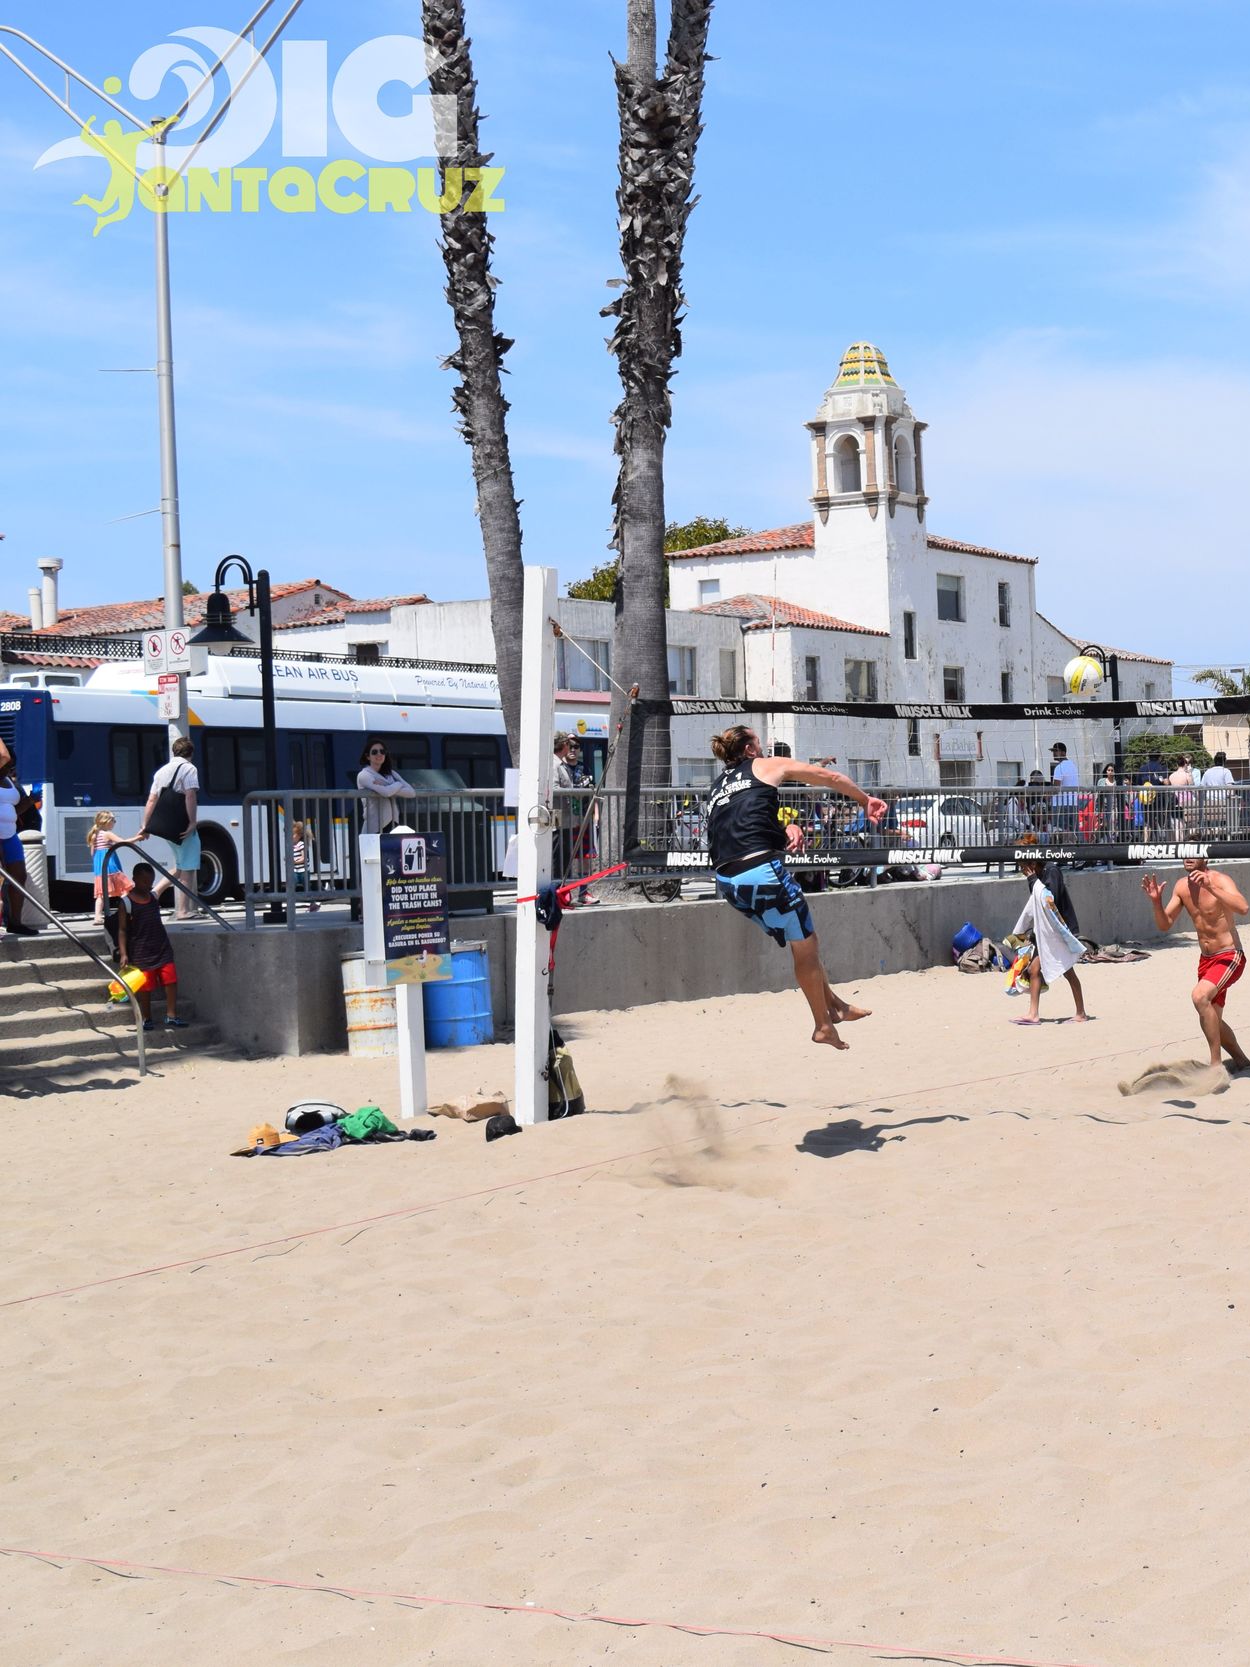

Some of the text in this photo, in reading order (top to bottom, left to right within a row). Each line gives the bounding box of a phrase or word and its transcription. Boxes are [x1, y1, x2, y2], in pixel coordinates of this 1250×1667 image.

[258, 664, 358, 682] EAN AIR BUS
[415, 675, 445, 686] Powered
[447, 677, 458, 690] By
[460, 679, 488, 689] Natural
[672, 701, 745, 714] MUSCLE MILK
[894, 704, 972, 718] MUSCLE MILK
[1136, 700, 1218, 716] MUSCLE MILK
[666, 852, 709, 866] MUSCLE
[785, 854, 812, 863] Drink.
[888, 850, 962, 864] MUSCLE MILK
[1014, 850, 1044, 859] Drink.
[1128, 844, 1209, 860] MUSCLE MILK
[402, 901, 421, 909] TRASH
